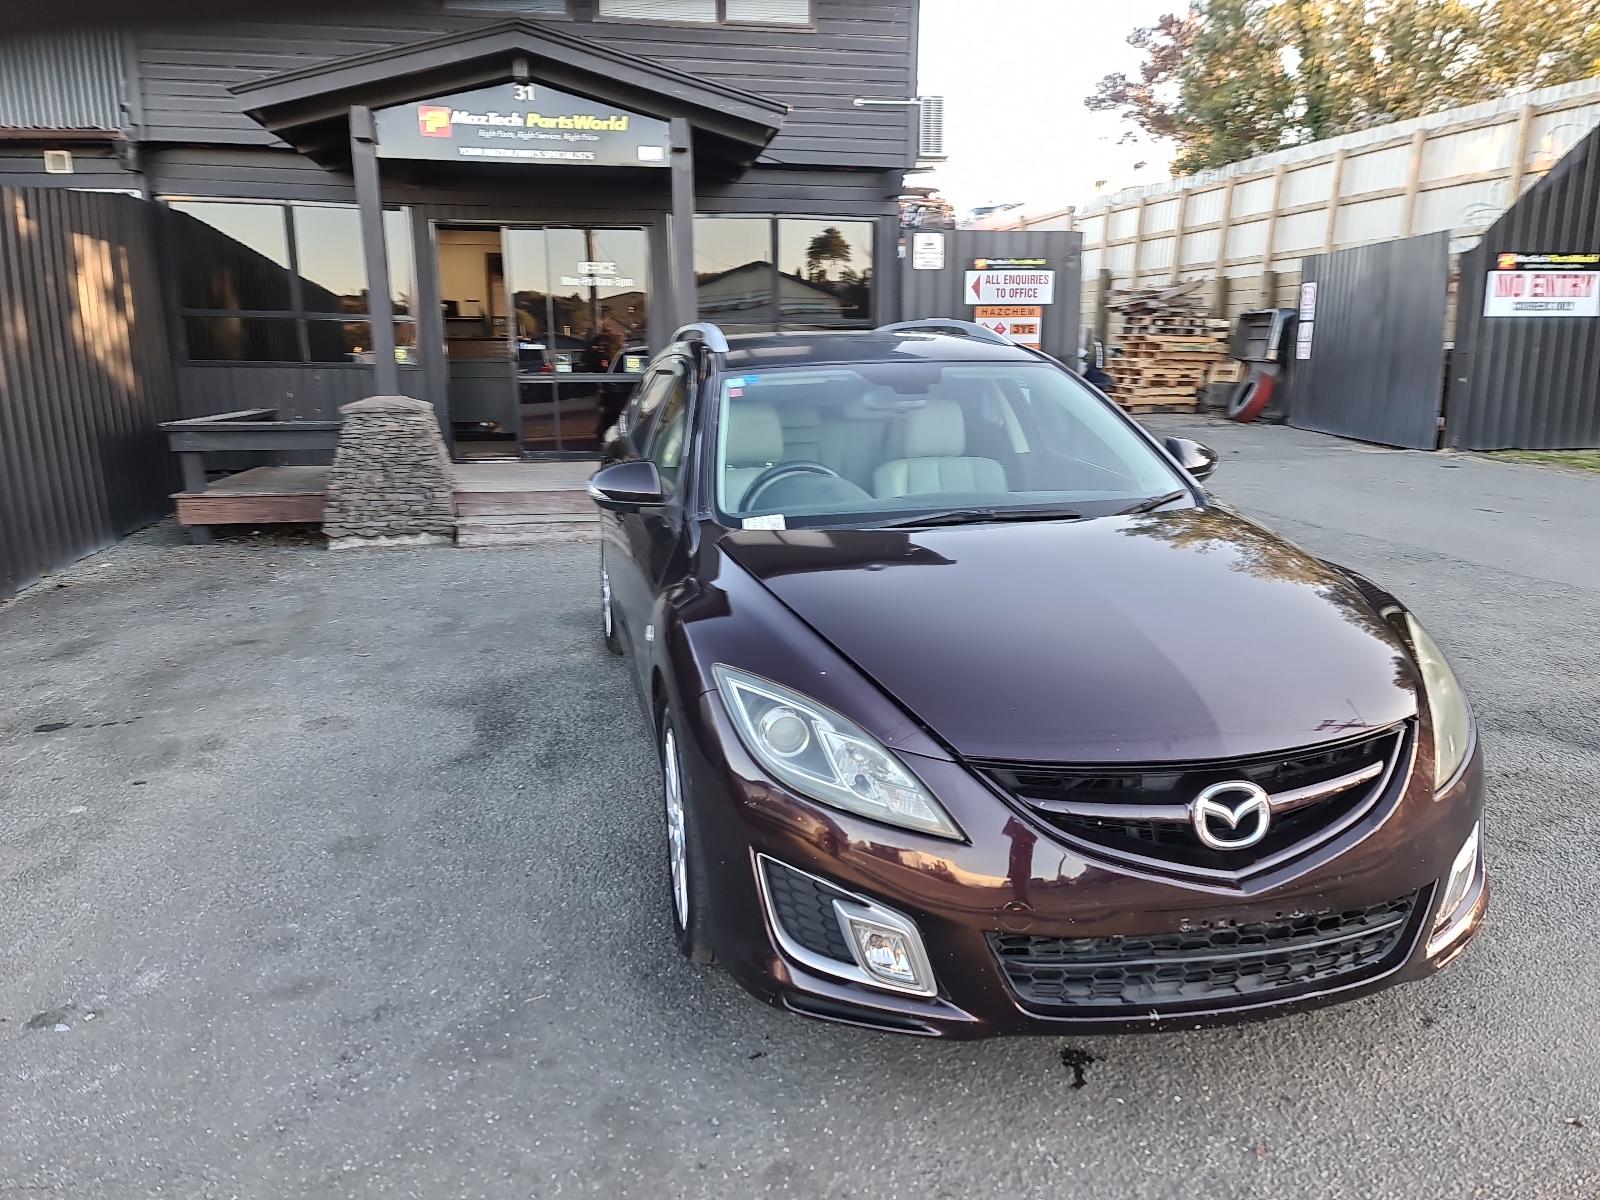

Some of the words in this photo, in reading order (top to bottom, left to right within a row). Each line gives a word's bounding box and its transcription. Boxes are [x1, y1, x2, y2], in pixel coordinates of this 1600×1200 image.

[513, 85, 536, 101] 31
[526, 112, 629, 131] PartsWorld
[985, 274, 1000, 285] ALL
[1003, 274, 1050, 286] ENQUIRIES
[1494, 273, 1526, 298] NO
[1529, 273, 1597, 298] ENTRY
[995, 287, 1006, 299] TO
[1008, 287, 1038, 298] OFFICE
[981, 307, 1035, 316] HAZCHEM
[1012, 323, 1035, 334] 3YE
